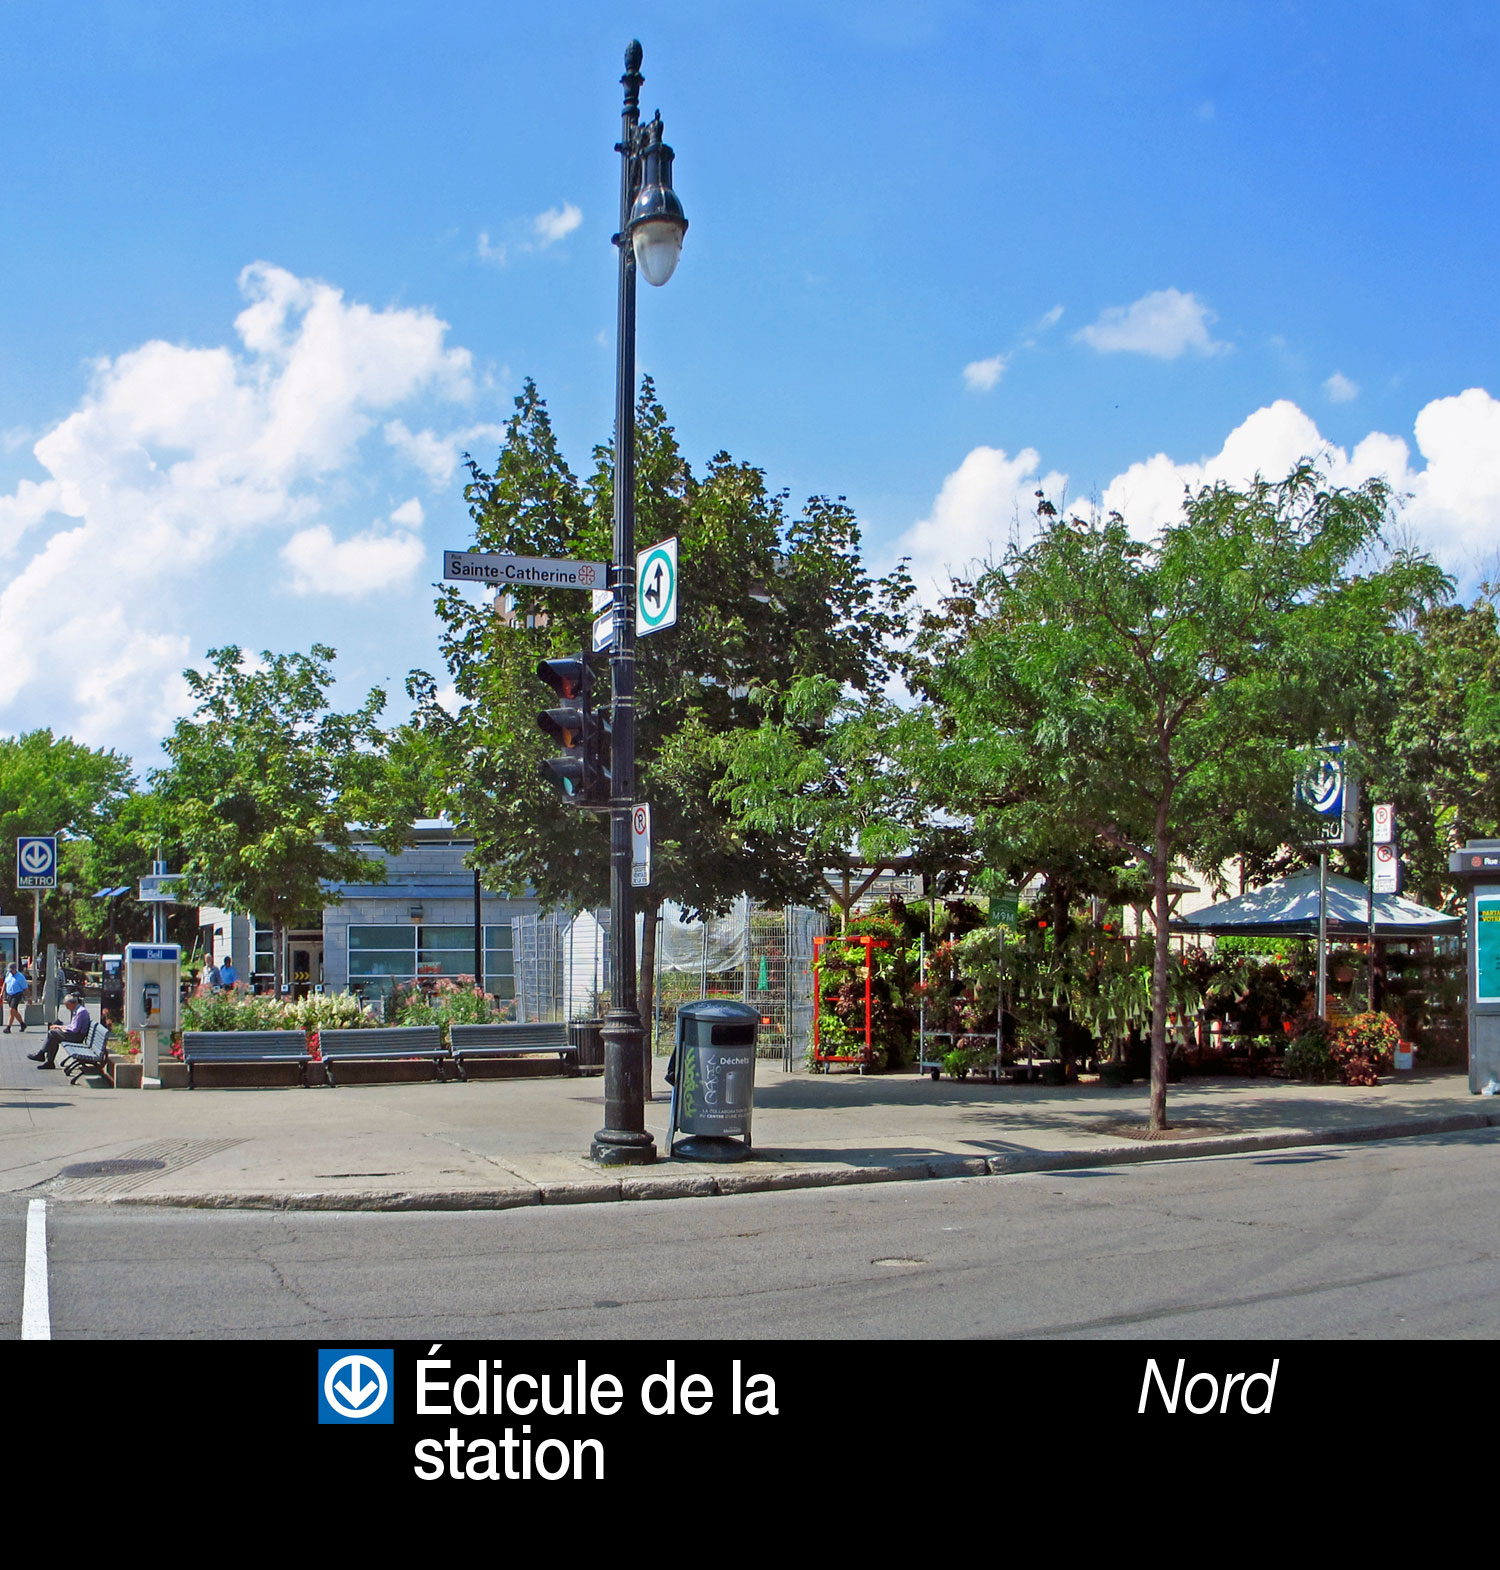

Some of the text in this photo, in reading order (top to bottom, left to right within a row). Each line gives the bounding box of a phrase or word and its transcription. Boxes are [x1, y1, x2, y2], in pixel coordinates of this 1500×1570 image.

[451, 561, 576, 584] Sainte-Catherine
[1484, 857, 1498, 865] Rue
[19, 876, 54, 886] METRO
[147, 950, 163, 959] Bell
[720, 1056, 750, 1065] Déchets
